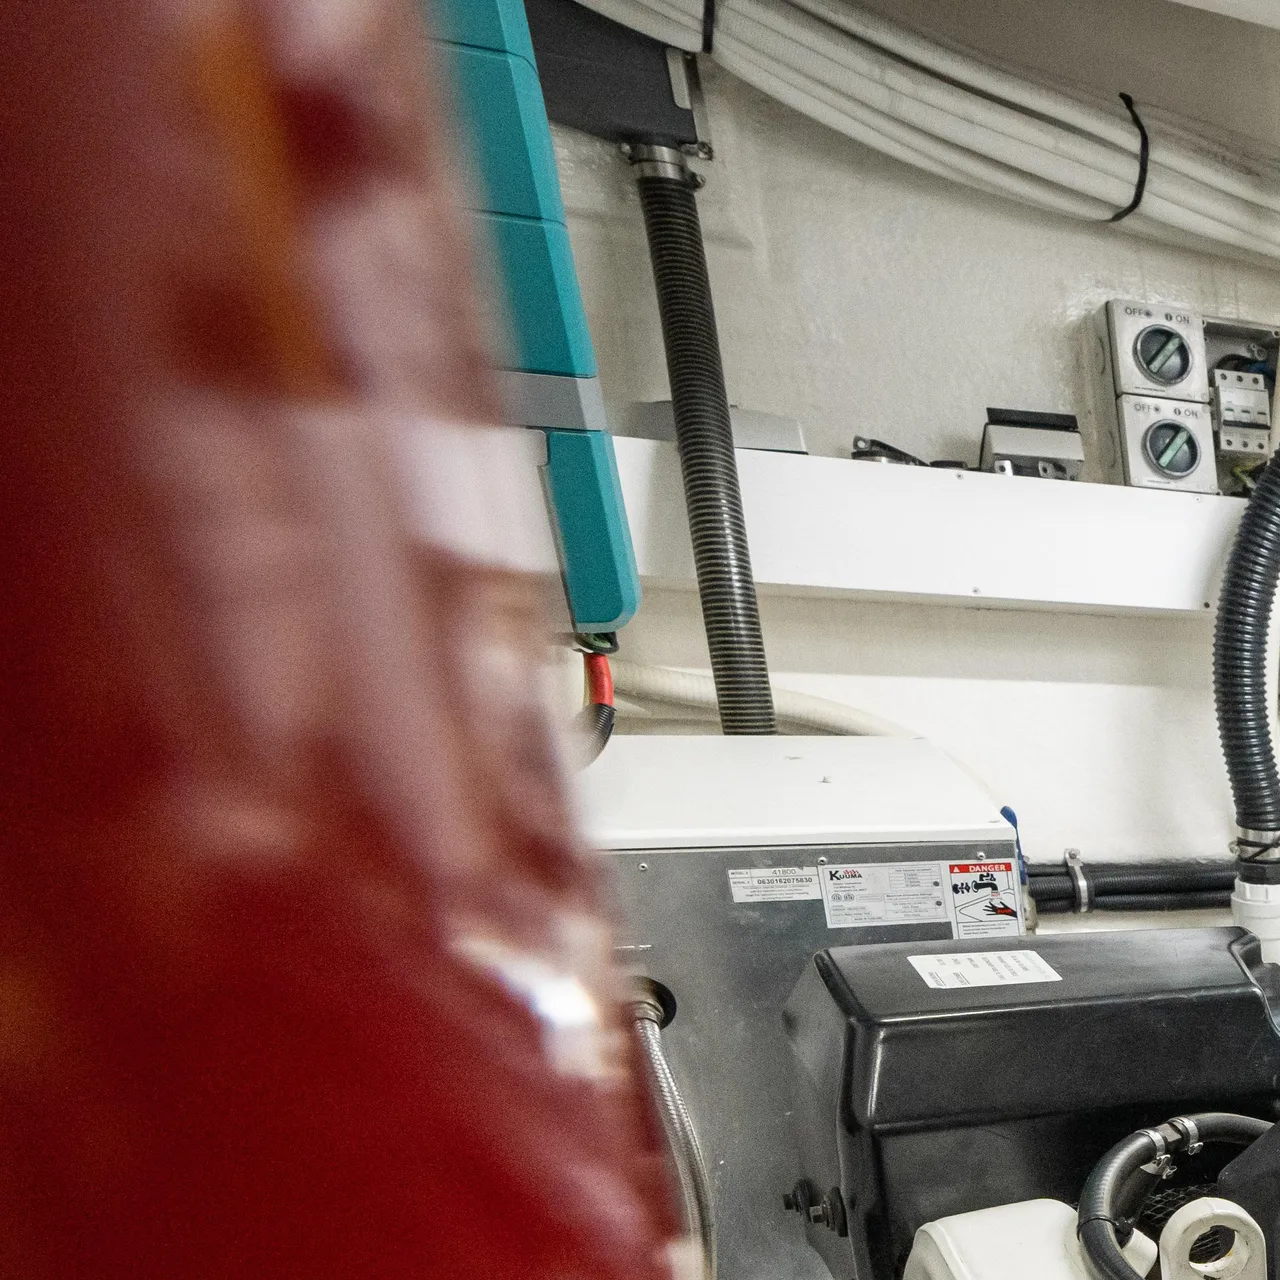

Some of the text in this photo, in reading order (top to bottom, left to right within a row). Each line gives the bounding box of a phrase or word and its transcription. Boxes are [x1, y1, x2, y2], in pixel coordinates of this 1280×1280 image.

[1125, 307, 1190, 324] OFF ON
[1134, 404, 1197, 417] OFF ON
[969, 864, 1006, 872] DANGER
[829, 870, 863, 881] KUUMA
